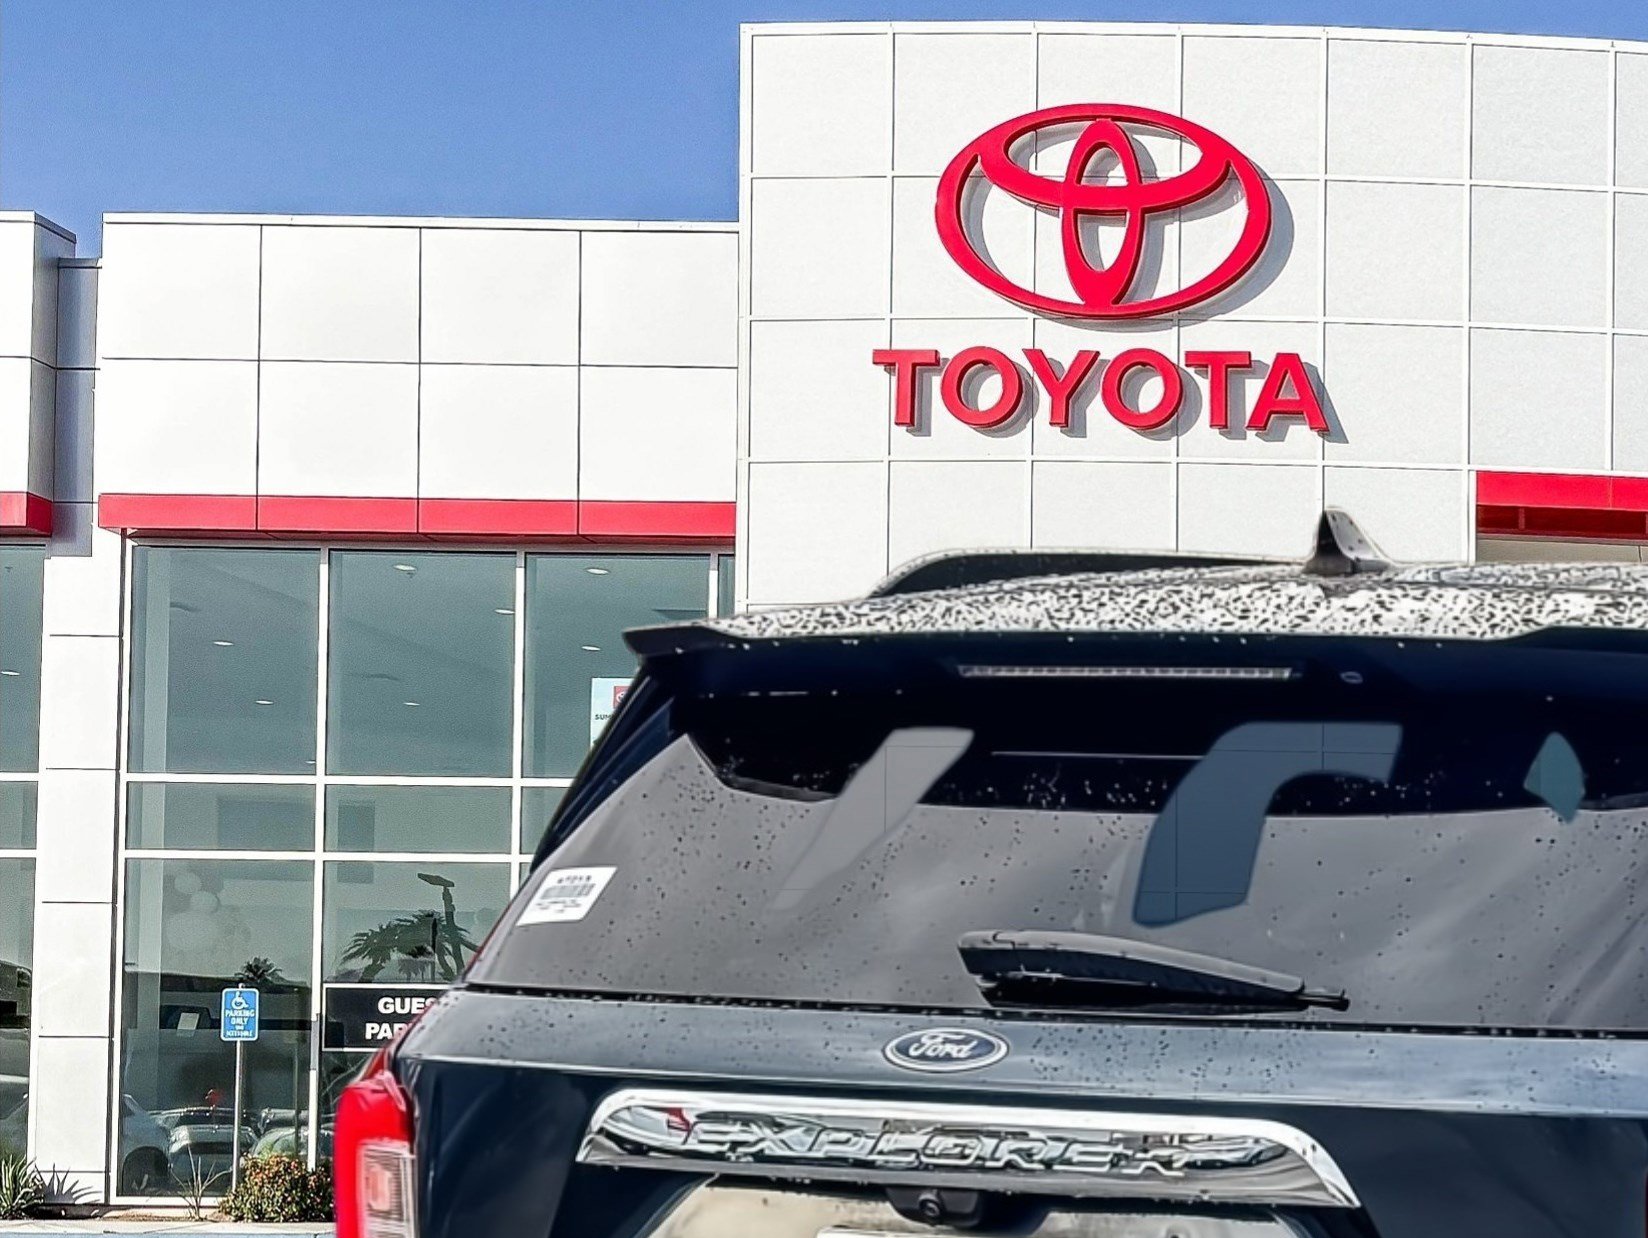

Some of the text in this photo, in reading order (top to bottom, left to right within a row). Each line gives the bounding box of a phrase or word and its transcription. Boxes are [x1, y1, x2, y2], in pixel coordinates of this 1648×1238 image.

[873, 346, 1329, 431] TOYOTA
[225, 1009, 255, 1018] PARKING
[908, 1031, 978, 1059] Ford
[682, 1118, 1188, 1177] EXPLORER
